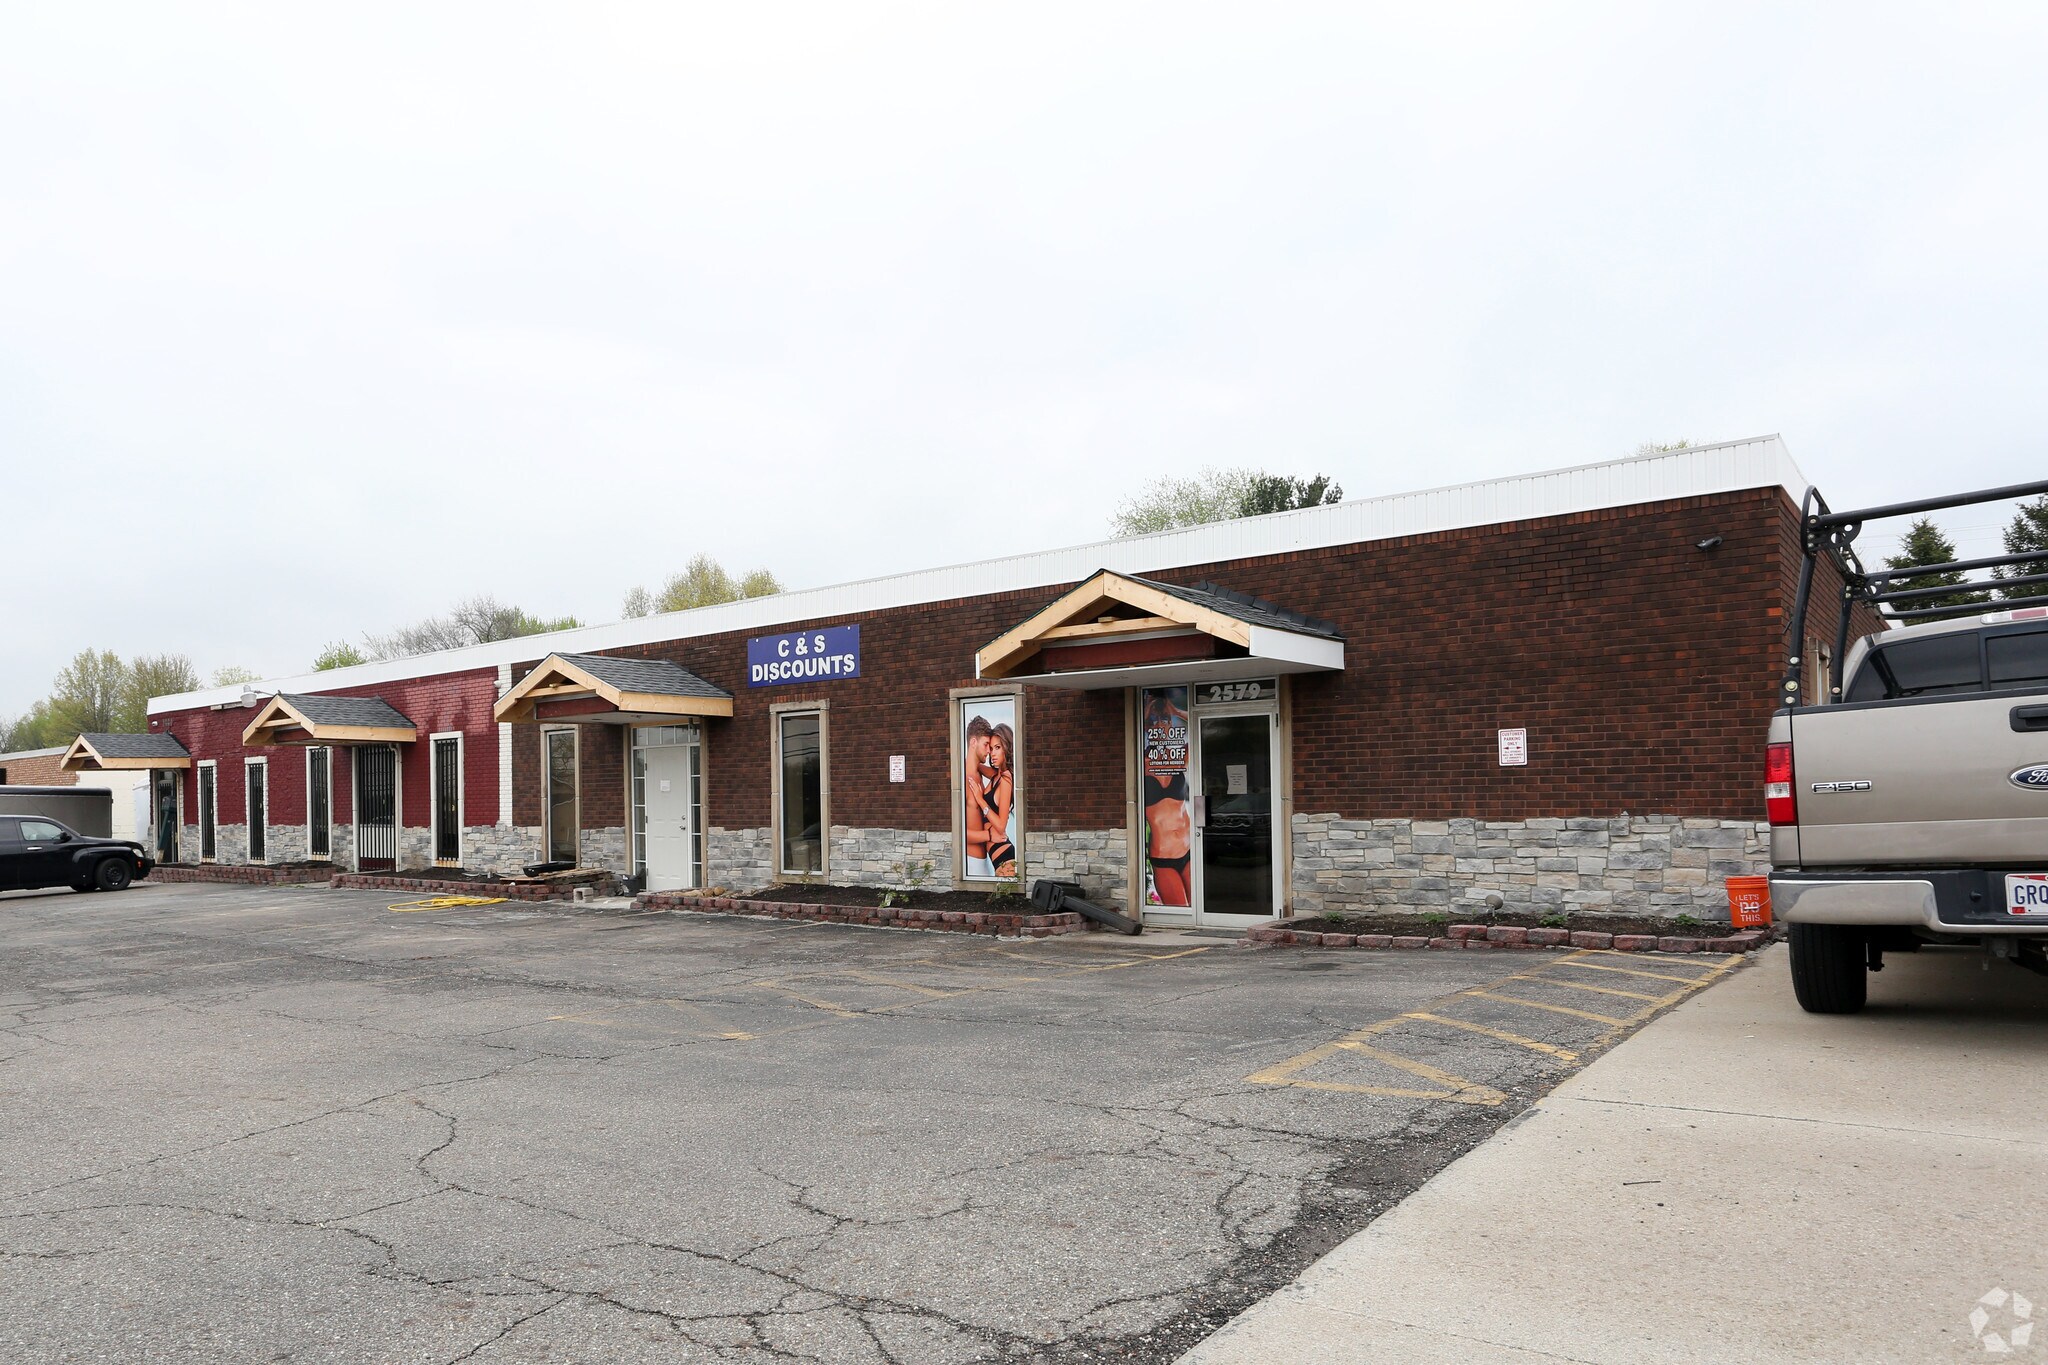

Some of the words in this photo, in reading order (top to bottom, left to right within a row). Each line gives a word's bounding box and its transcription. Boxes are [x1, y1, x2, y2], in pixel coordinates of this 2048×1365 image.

[777, 639, 790, 658] C
[795, 637, 809, 656] &
[813, 634, 826, 654] S
[752, 653, 856, 682] DISCOUNTS
[1209, 683, 1261, 702] 2579
[1147, 728, 1167, 739] 25%
[1168, 727, 1186, 738] OFF
[1169, 748, 1186, 759] OFF
[1739, 901, 1760, 914] DO
